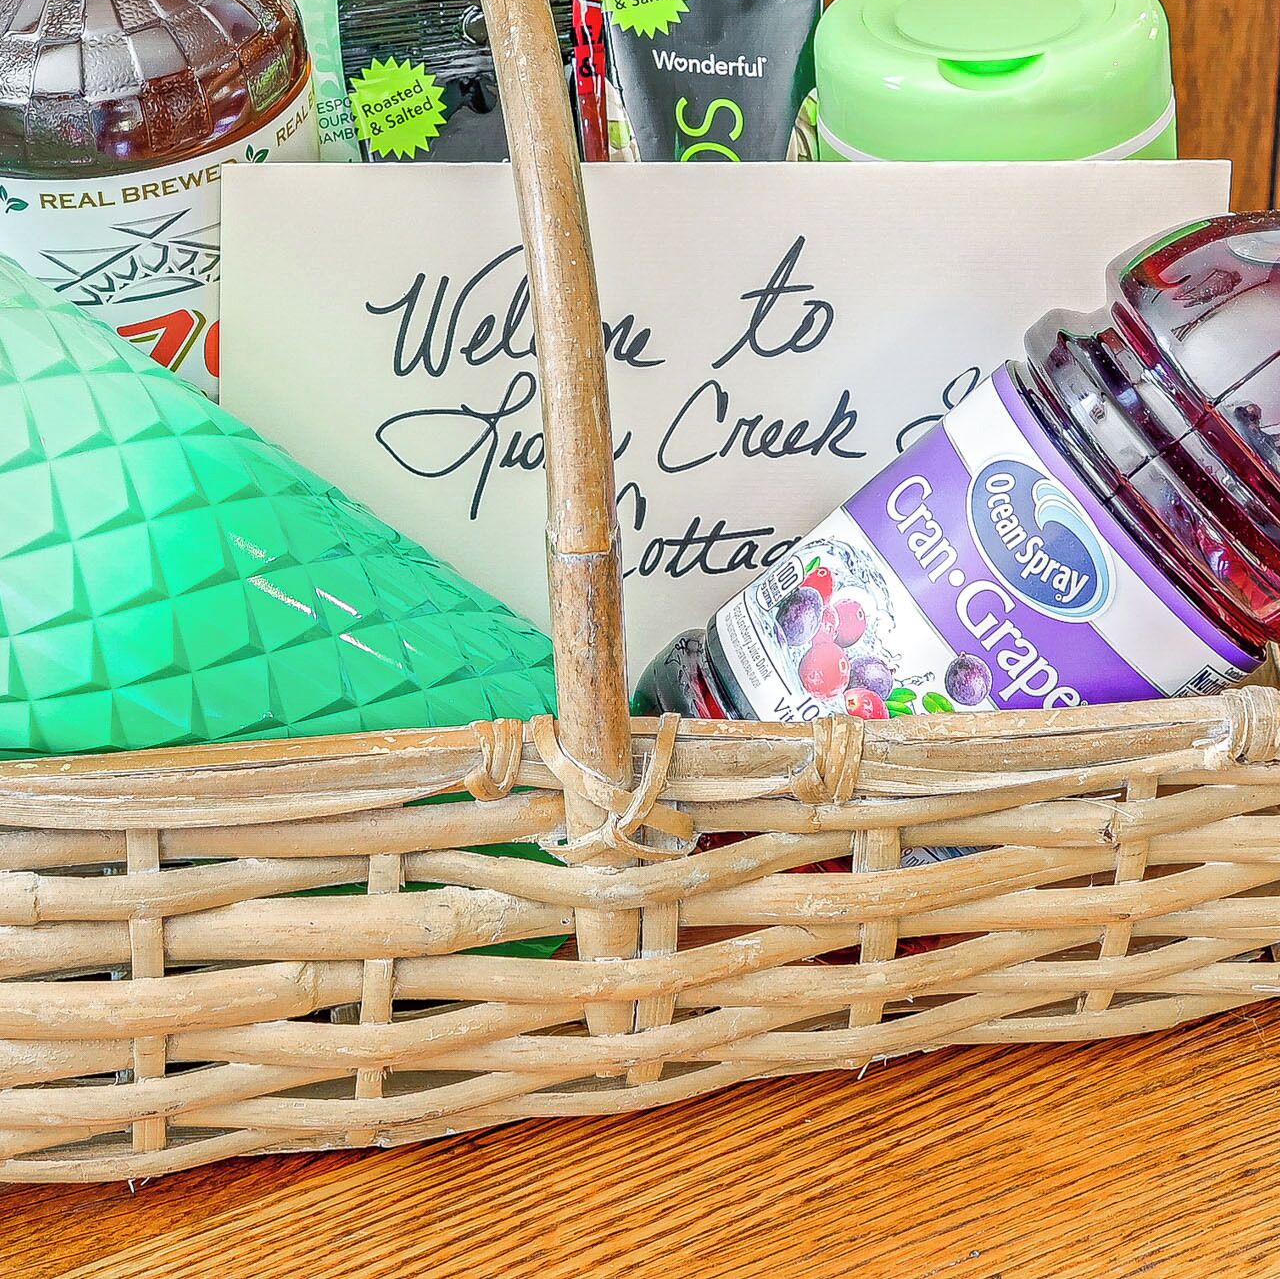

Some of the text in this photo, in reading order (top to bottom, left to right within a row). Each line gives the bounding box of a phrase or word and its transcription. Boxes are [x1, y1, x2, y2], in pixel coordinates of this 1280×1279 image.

[652, 48, 763, 78] Wonderful
[361, 79, 424, 118] Roasted
[370, 96, 433, 136] & Salted
[276, 113, 309, 147] REAL
[39, 158, 238, 210] REAL BREWE
[711, 235, 835, 369] to
[658, 379, 866, 473] Creek
[984, 472, 1090, 604] Ocean Spray
[776, 561, 798, 592] 100
[747, 642, 761, 661] Juice
[754, 657, 774, 681] Drink
